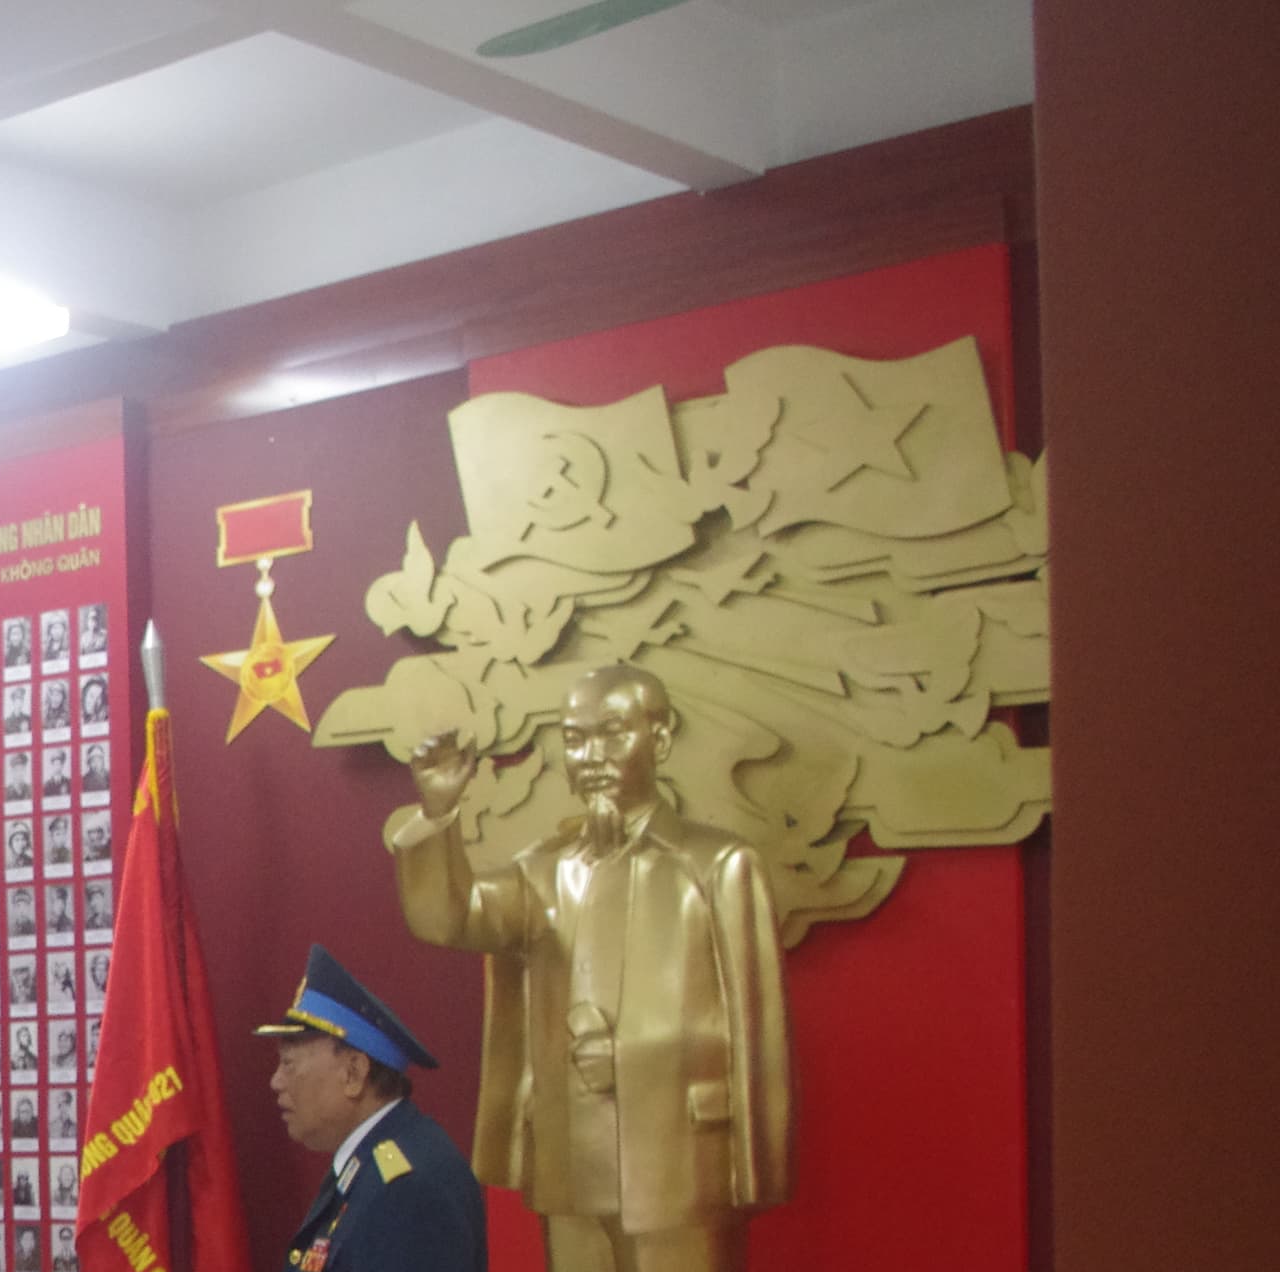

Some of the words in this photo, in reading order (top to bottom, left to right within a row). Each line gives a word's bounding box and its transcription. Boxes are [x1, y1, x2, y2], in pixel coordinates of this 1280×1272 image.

[20, 511, 65, 549] NHÂN
[67, 502, 101, 540] DÂN
[0, 559, 54, 583] KHÔNG
[56, 547, 101, 573] QUÂN
